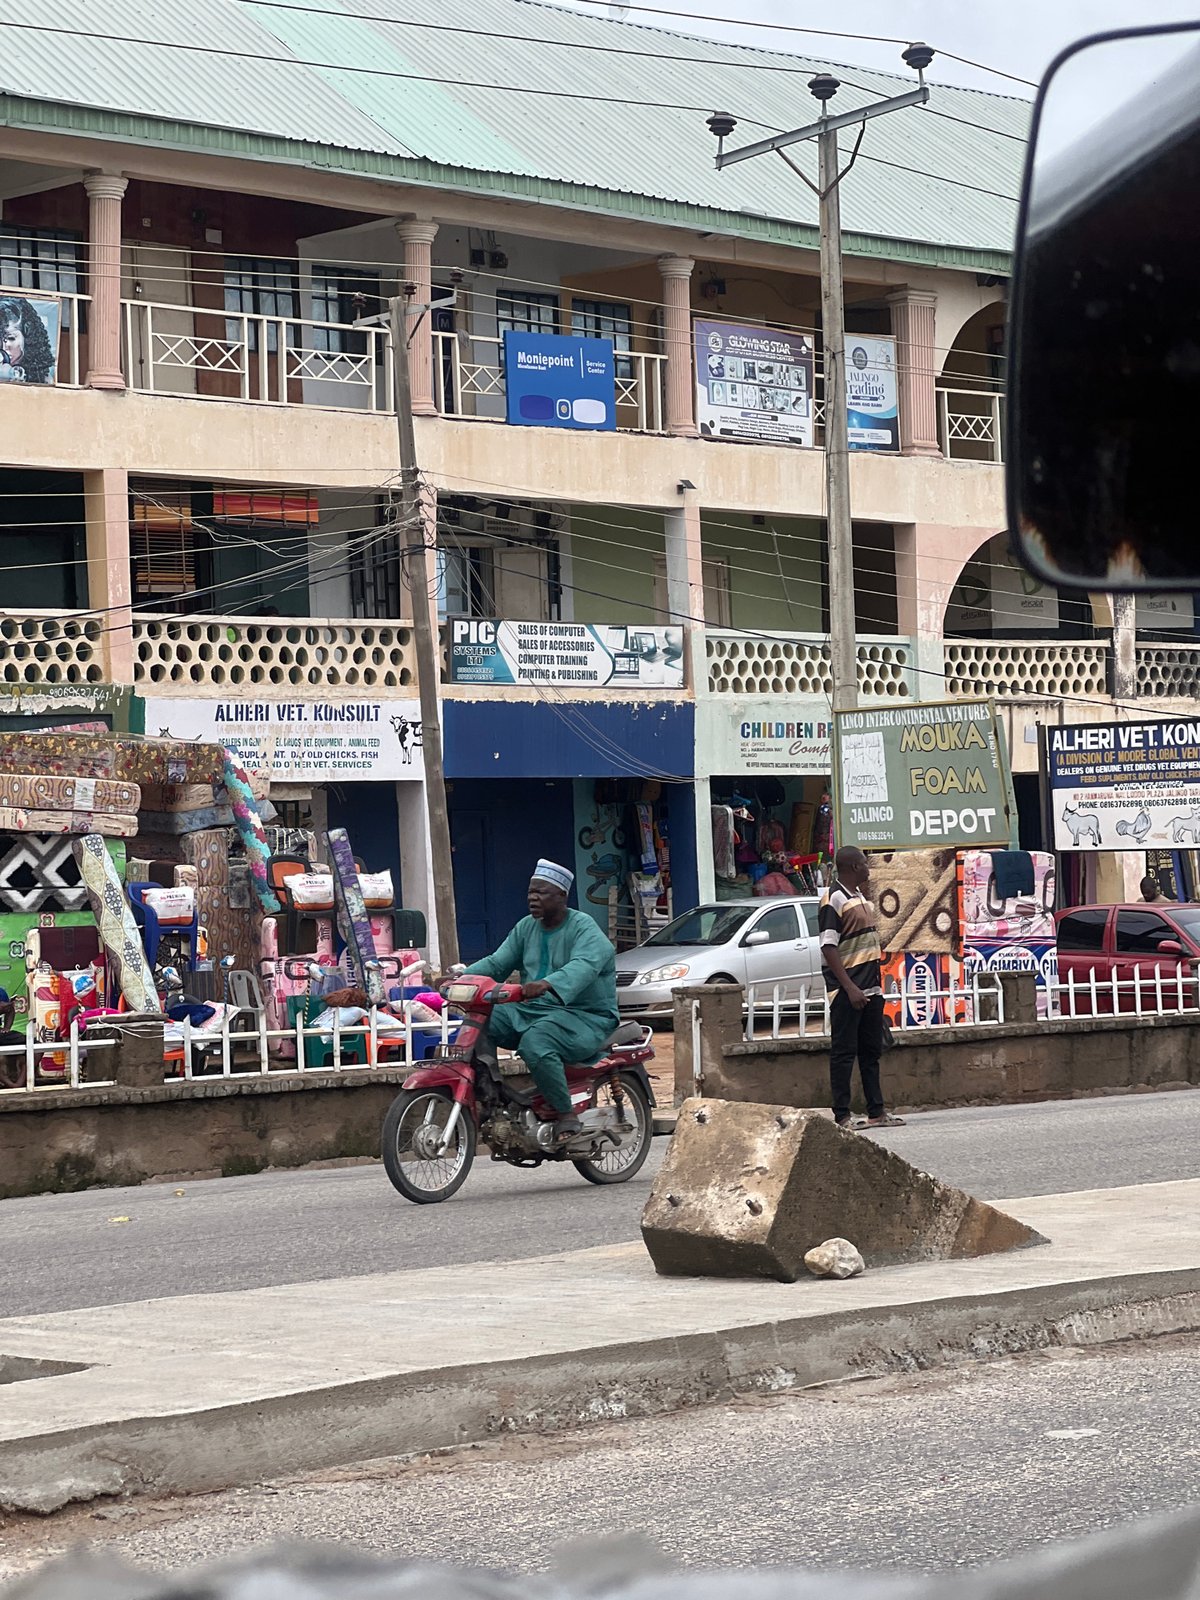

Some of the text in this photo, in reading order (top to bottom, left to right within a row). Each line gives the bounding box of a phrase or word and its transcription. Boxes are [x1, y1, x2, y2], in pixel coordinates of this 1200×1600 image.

[728, 335, 790, 355] GLOWING STAR
[518, 352, 574, 368] Moniepoint
[850, 372, 880, 382] JALINGO
[454, 620, 495, 644] PIC
[518, 624, 586, 637] SALES OF COMPUTER
[454, 646, 496, 656] SYSTEMS
[518, 639, 595, 652] SALES OF ACCESSORIES
[467, 656, 484, 666] LTD
[518, 654, 588, 666] COMPUTER TRAINING
[518, 668, 598, 680] PRINTING & PUBLISHING
[214, 704, 381, 722] ALHERI VET. KONSULT
[841, 704, 991, 730] LINCO INTERCONTINENTAL VENTURES
[740, 722, 814, 738] CHILDREN
[900, 721, 988, 753] MOUKA
[1052, 723, 1200, 751] ALHERI VET. KON
[218, 738, 241, 746] DEALERS
[242, 738, 248, 746] IN
[303, 738, 312, 747] VET.
[315, 738, 343, 748] EQUIPMENT
[348, 738, 368, 748] ANIMAL
[368, 738, 380, 748] FEED
[1066, 752, 1102, 764] DIVISION
[1104, 752, 1116, 763] OF
[1118, 750, 1146, 762] MOORE
[1148, 748, 1180, 760] GLOBAL
[1056, 766, 1084, 776] DEALERS
[1085, 766, 1094, 774] ON
[1096, 764, 1122, 774] GENUINE
[1135, 762, 1156, 771] DRUGS
[910, 766, 988, 796] FOAM
[1080, 775, 1097, 783] FEED
[1138, 772, 1150, 780] DAY
[1120, 782, 1140, 790] OTHER
[1166, 789, 1188, 797] JALINGO
[850, 806, 894, 824] JALINGO
[910, 808, 996, 836] DEPOT
[990, 960, 1036, 971] GIMBIYA
[915, 965, 926, 1022] GIMIYA
